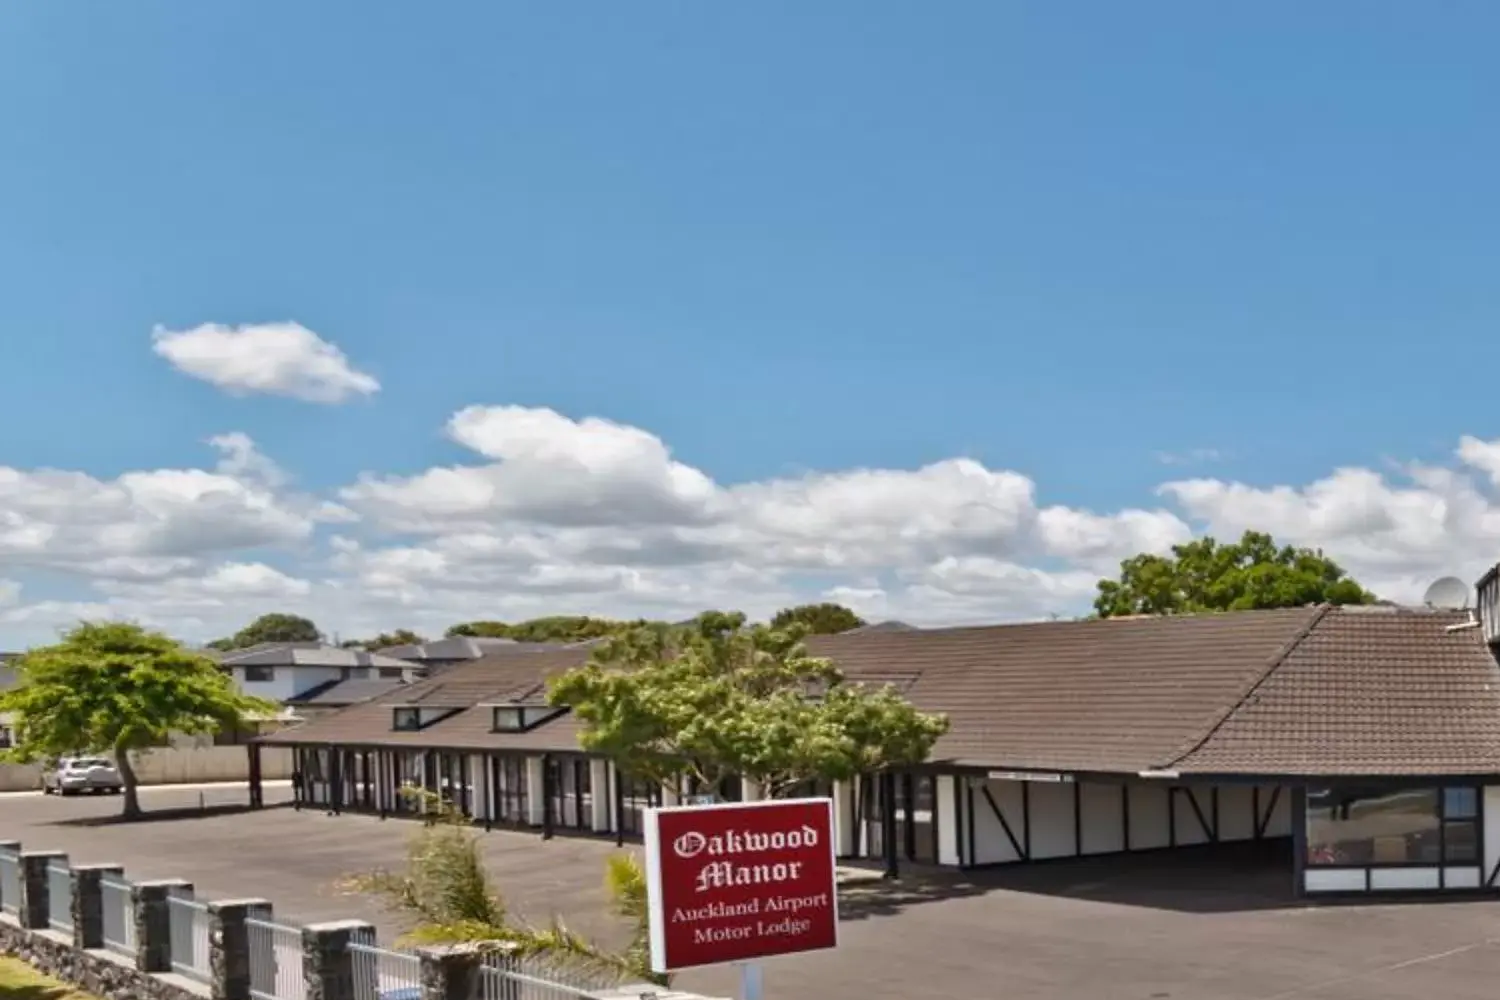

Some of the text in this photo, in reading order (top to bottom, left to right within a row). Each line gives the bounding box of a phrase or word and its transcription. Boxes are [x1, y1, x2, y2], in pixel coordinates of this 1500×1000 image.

[673, 825, 818, 857] Oakwood
[695, 861, 802, 891] Manor
[672, 894, 827, 922] Auckland Airport
[694, 917, 810, 944] Motor Lodge
